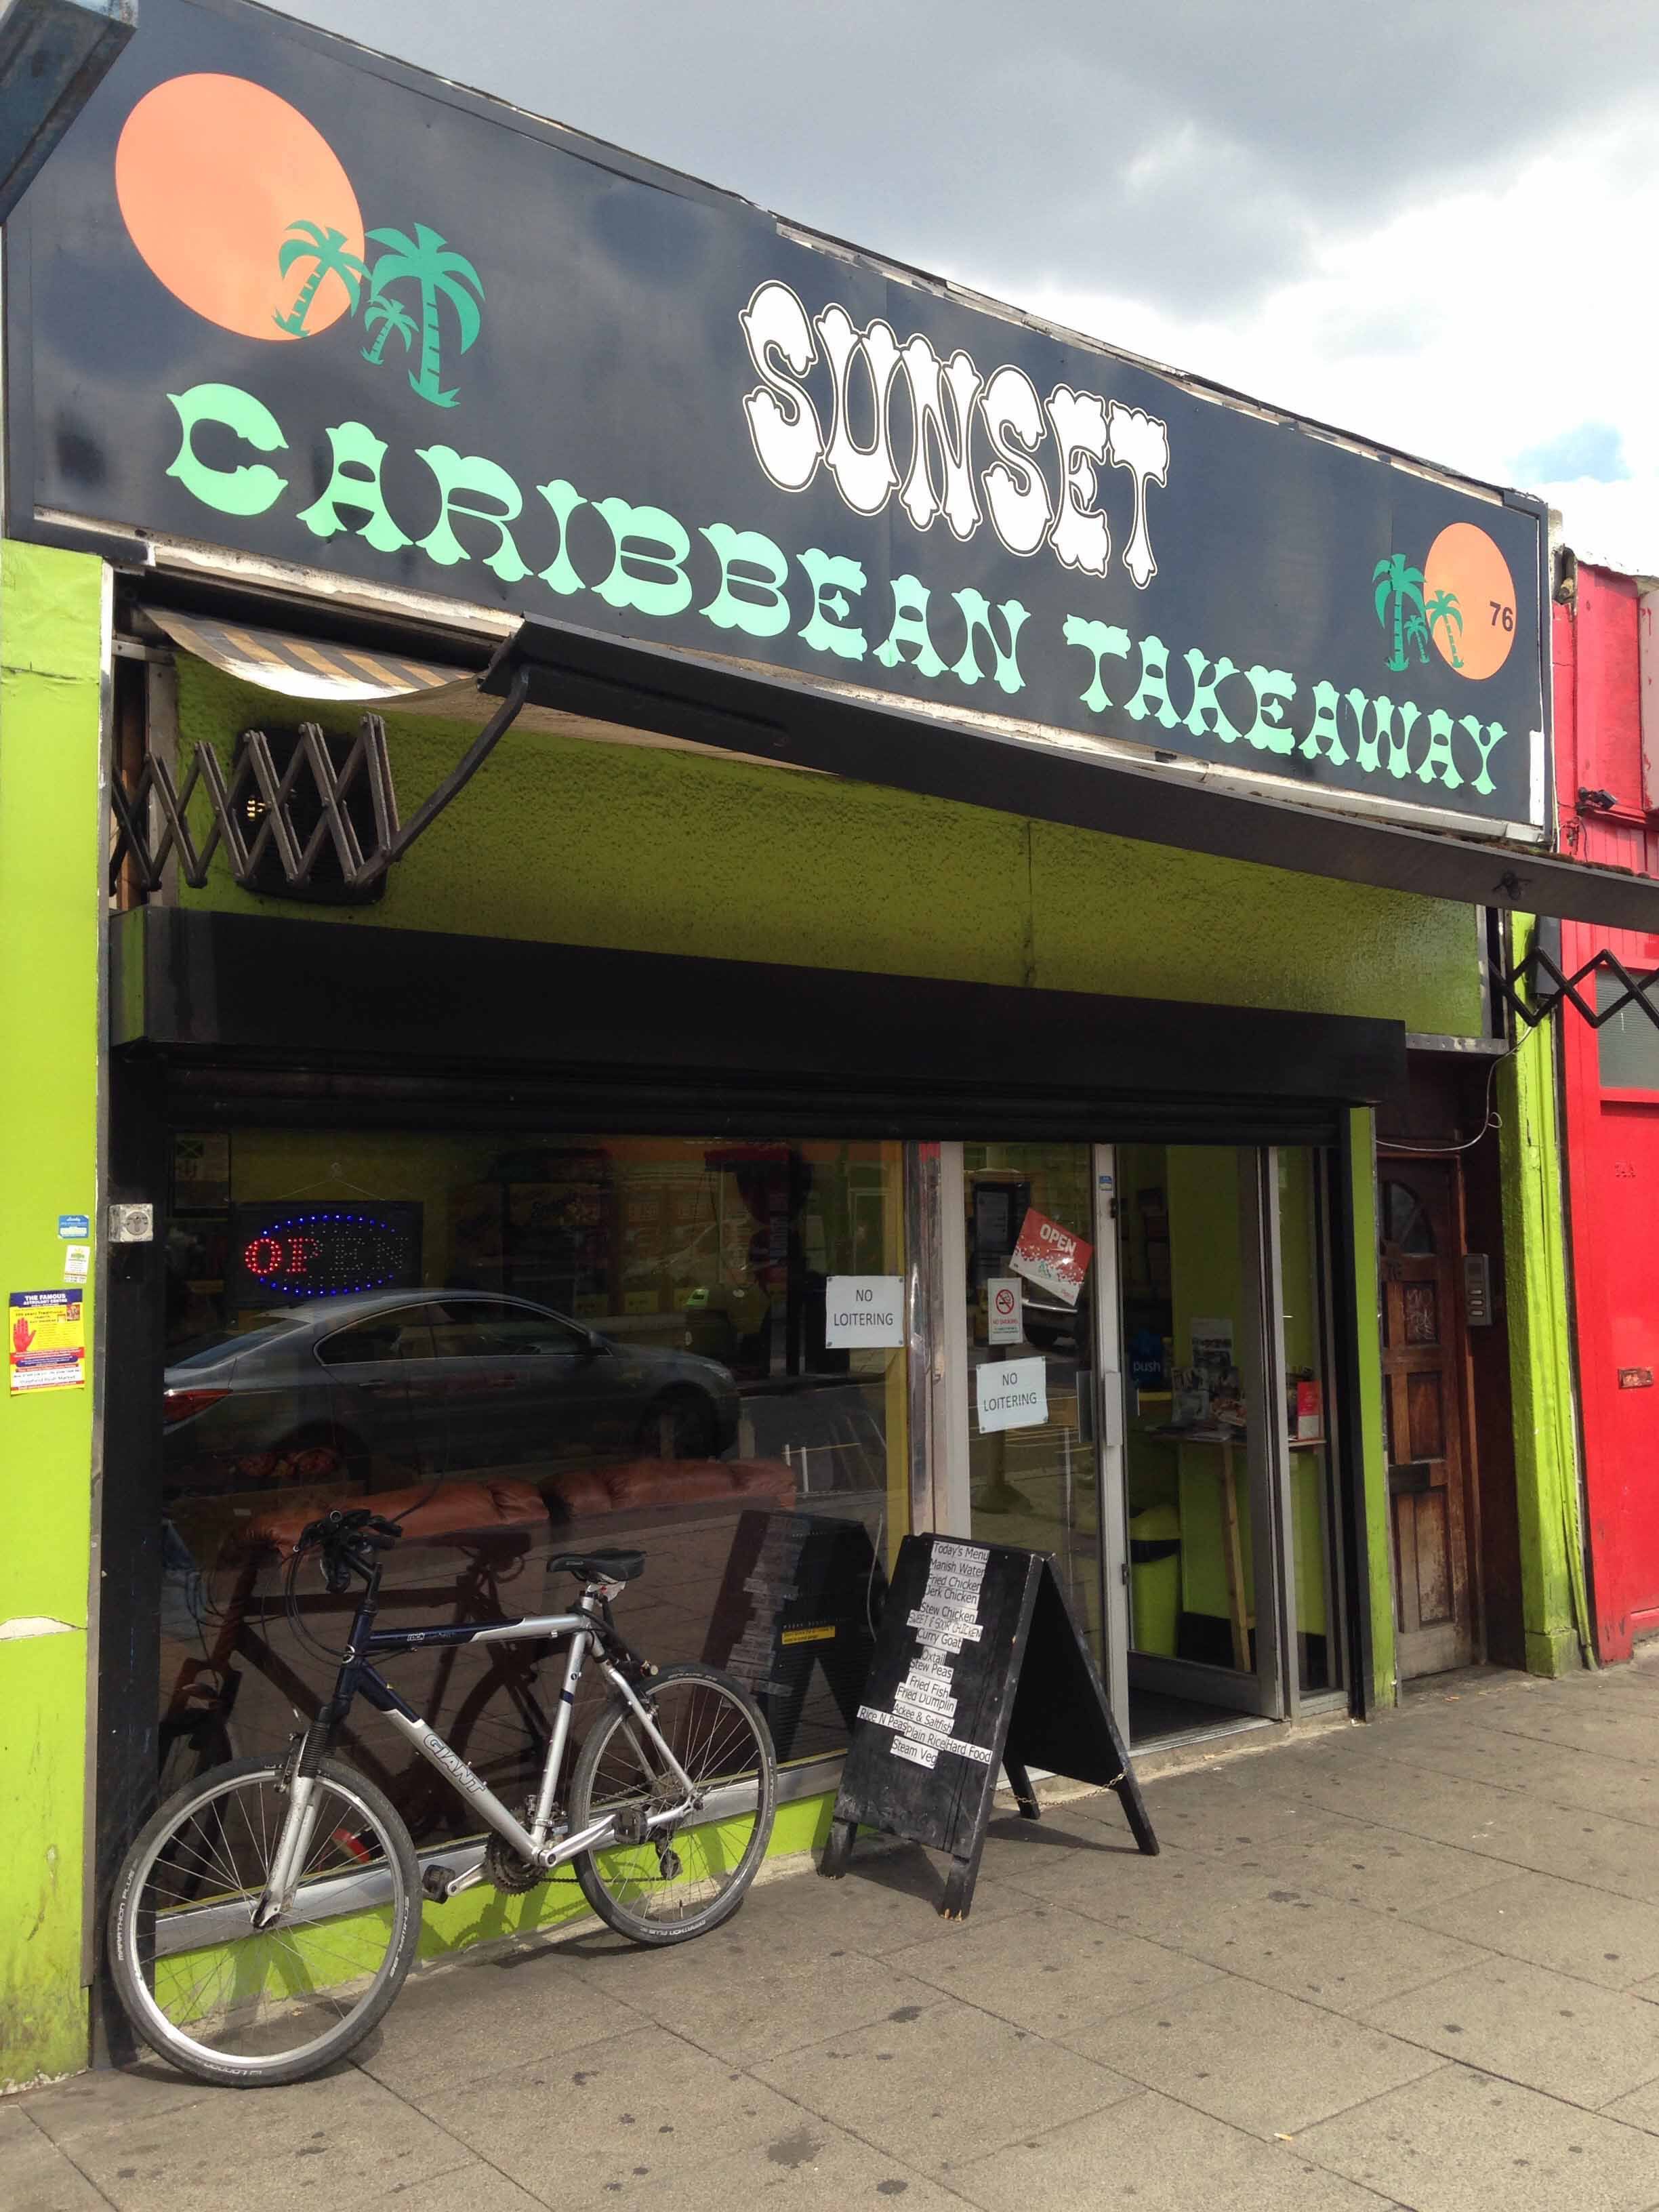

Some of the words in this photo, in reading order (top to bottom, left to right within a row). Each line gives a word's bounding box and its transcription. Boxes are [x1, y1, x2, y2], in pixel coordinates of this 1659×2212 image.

[738, 280, 1169, 589] SUNSET
[166, 383, 1031, 693] CARIBBEAN
[1062, 614, 1508, 794] TAKEAWAY
[1490, 600, 1513, 632] 76
[1040, 1223, 1076, 1256] OPEN
[856, 1289, 873, 1302] NO
[834, 1313, 894, 1326] LOITERING
[1133, 1359, 1161, 1372] push
[1002, 1372, 1017, 1386] NO
[984, 1392, 1037, 1412] LOITERING
[933, 1542, 963, 1558] Today's
[965, 1547, 987, 1561] Menu
[960, 1563, 985, 1576] Water
[925, 1584, 942, 1598] Jerk
[945, 1588, 977, 1604] Chicken
[949, 1576, 982, 1591] Chicken
[920, 1601, 940, 1615] Stew
[942, 1606, 975, 1623] Chicken
[918, 1627, 939, 1644] Curry
[941, 1633, 962, 1649] Goat
[922, 1648, 946, 1665] Oxtail
[910, 1658, 930, 1672] Stew
[932, 1663, 952, 1679] Peas
[909, 1675, 930, 1692] Fried
[931, 1683, 949, 1699] Fish
[897, 1686, 917, 1701] Fried
[918, 1694, 956, 1712] Dumplin
[860, 1708, 878, 1722] Rice
[878, 1713, 887, 1725] N
[888, 1715, 907, 1732] Peas
[895, 1703, 914, 1719] Ackee
[916, 1712, 922, 1722] &
[924, 1715, 952, 1735] Saltfish
[905, 1725, 926, 1742] Plain
[927, 1733, 945, 1749] Rice
[892, 1738, 918, 1757] Steam
[921, 1748, 937, 1766] Veg
[946, 1738, 967, 1755] Hard
[969, 1746, 991, 1763] Food
[424, 1734, 485, 1793] GIANT
[122, 1870, 135, 1899] PLUS
